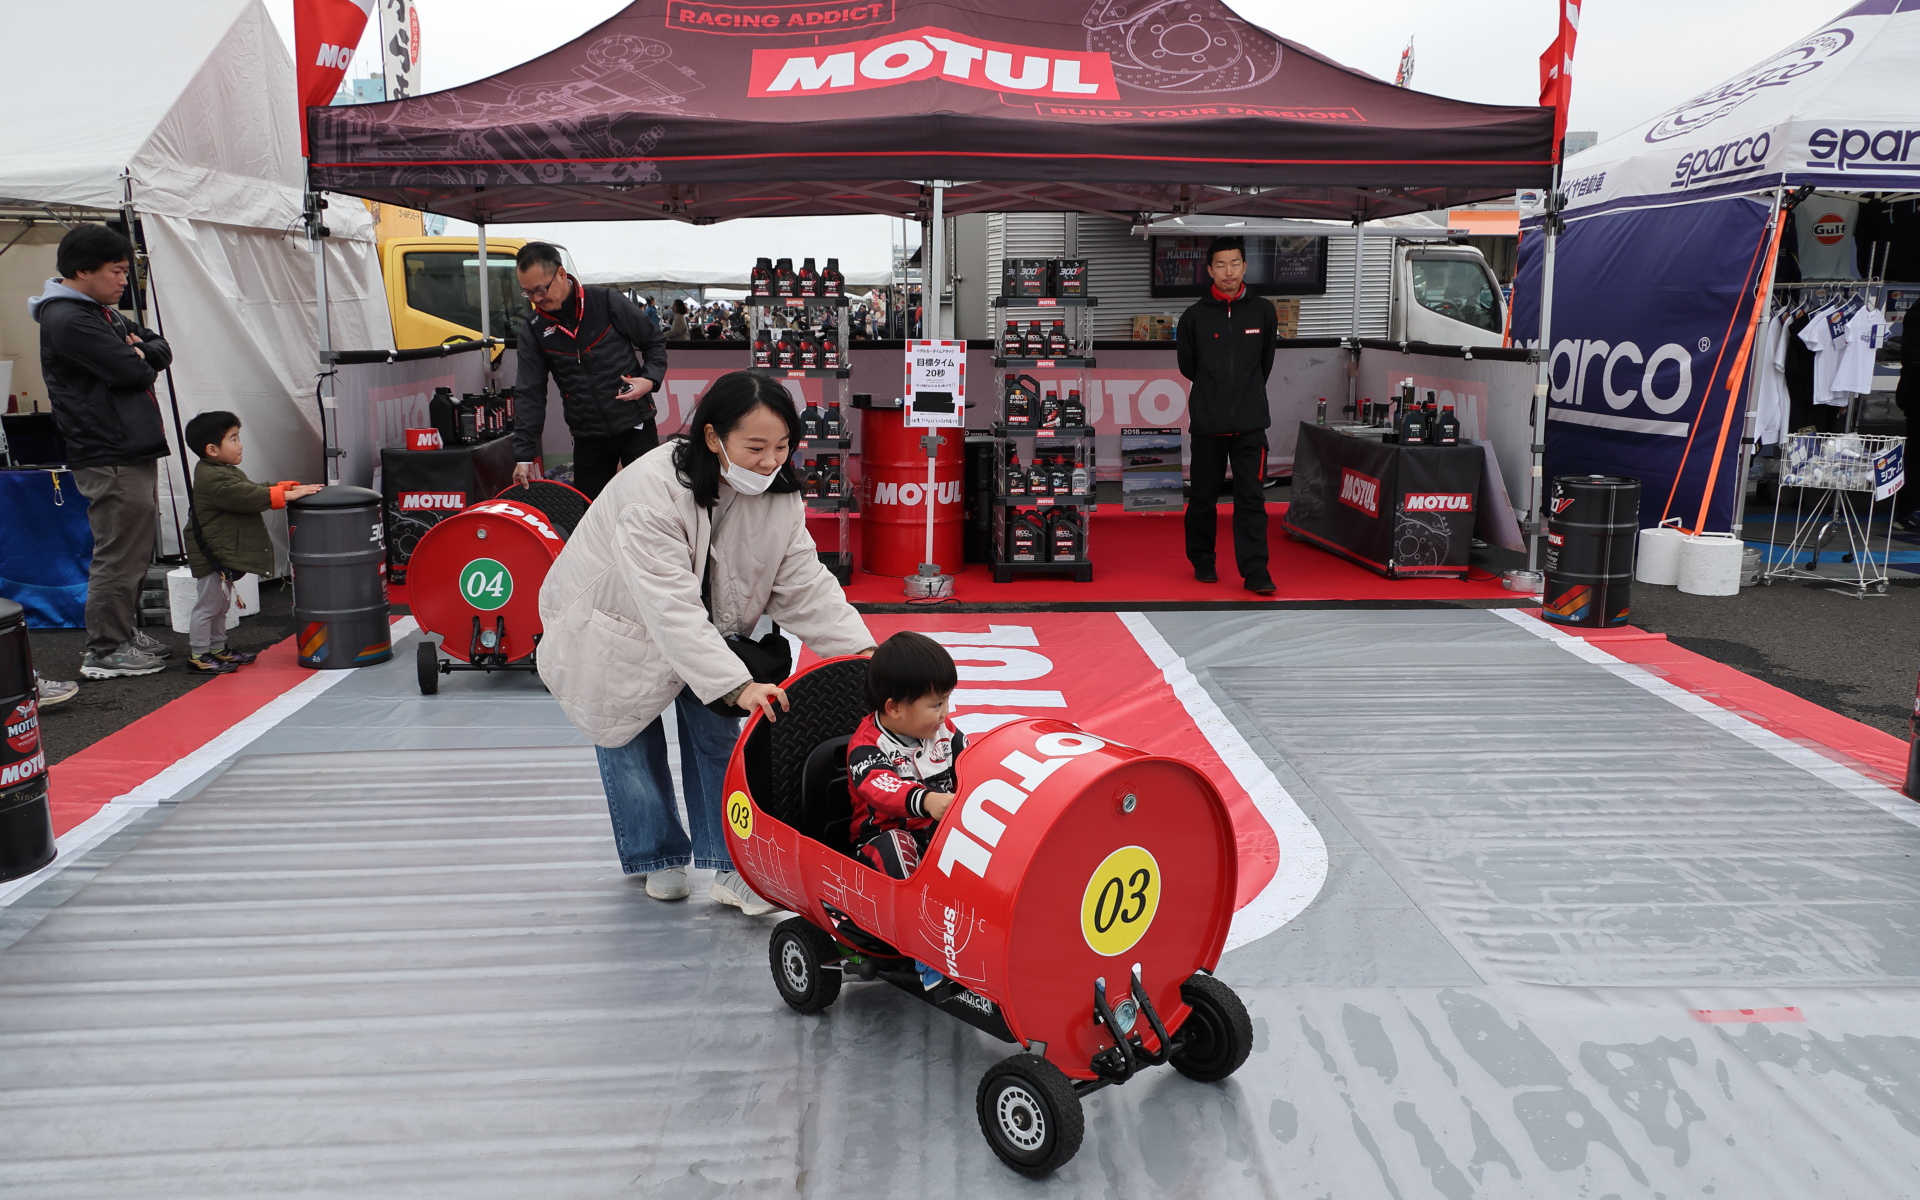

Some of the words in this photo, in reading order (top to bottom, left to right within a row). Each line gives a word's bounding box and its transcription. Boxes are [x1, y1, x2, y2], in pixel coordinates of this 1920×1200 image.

[680, 8, 780, 28] RACING
[787, 3, 880, 26] ADDICT
[766, 35, 1099, 94] MOTUL
[1050, 106, 1134, 118] BUILD
[1144, 106, 1218, 118] YOUR
[1228, 106, 1349, 120] PASSION
[1672, 132, 1770, 187] sparco
[1814, 225, 1846, 236] Gulf
[1166, 251, 1201, 259] MARTINI
[1020, 267, 1045, 275] 300V
[1059, 267, 1085, 275] 300V
[916, 358, 955, 367] 目標タイム
[925, 369, 946, 378] 20秒
[1548, 338, 1692, 414] arco
[403, 494, 464, 508] MOTUL
[1340, 474, 1377, 512] MOTUL
[1407, 496, 1469, 510] MOTUL
[467, 571, 504, 598] 04
[0, 750, 46, 786] MOTU
[731, 802, 750, 829] 03
[937, 732, 1106, 878] OTUL
[1094, 868, 1150, 934] 03
[943, 906, 960, 978] SPECIA
